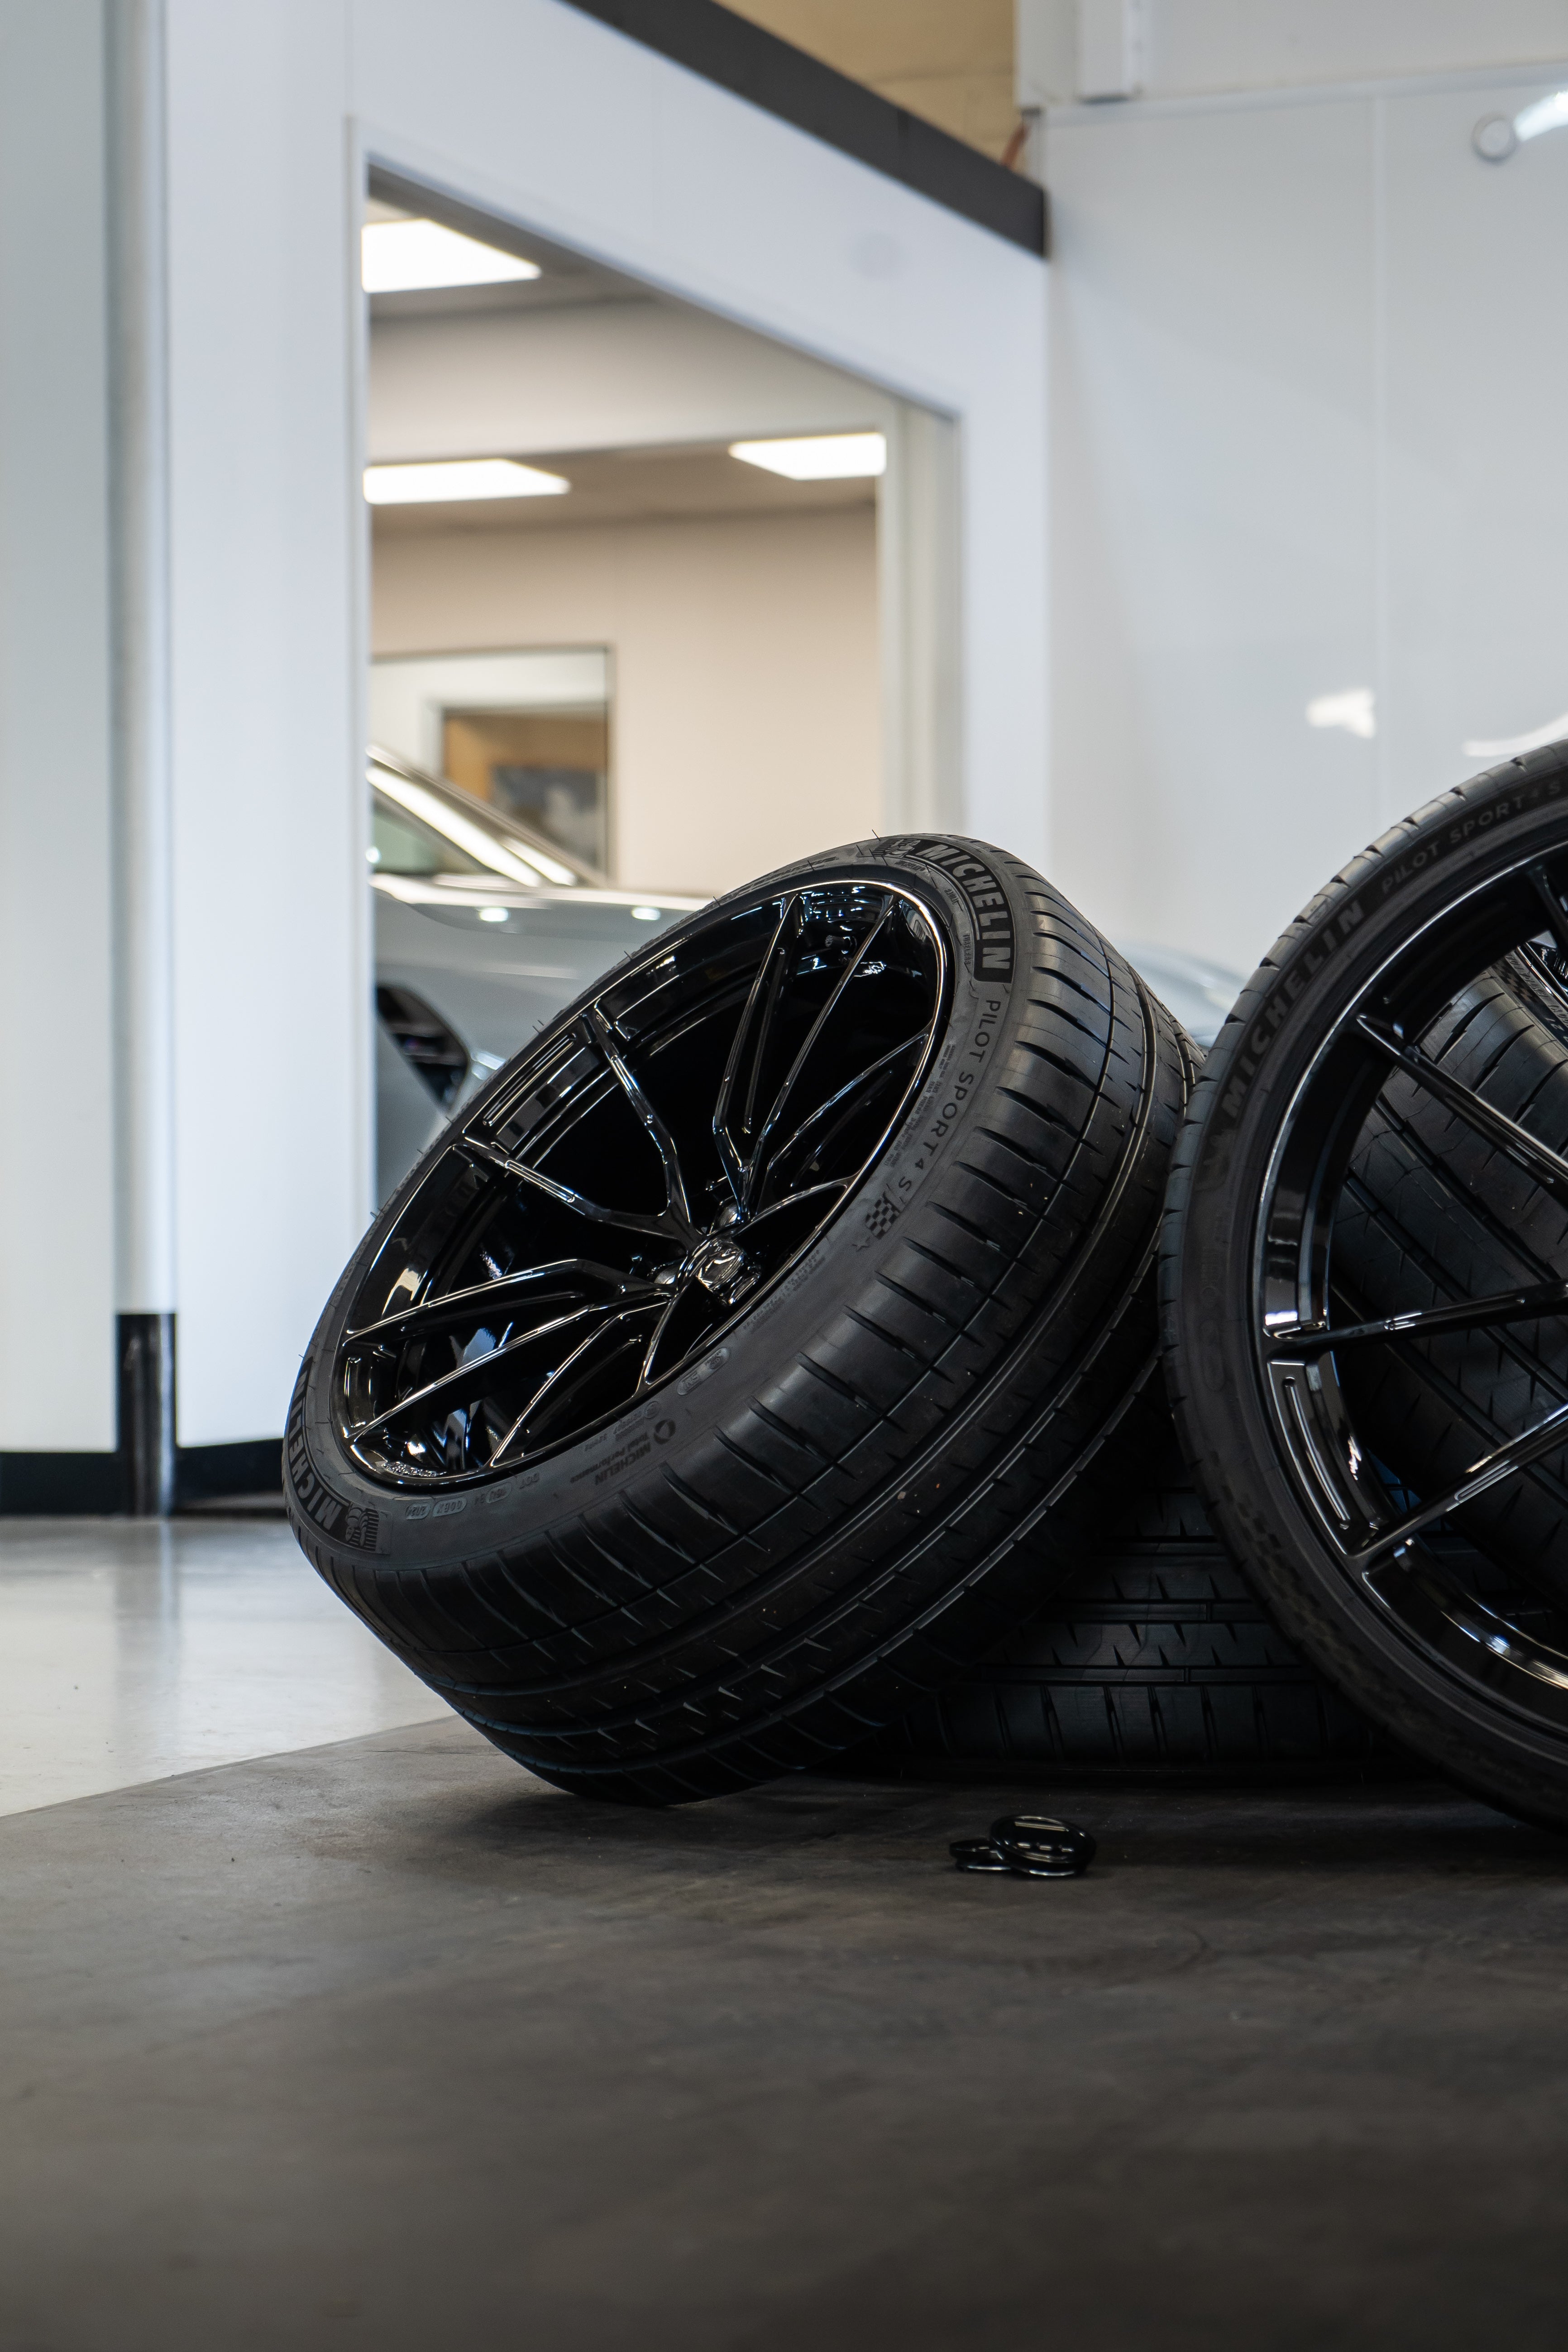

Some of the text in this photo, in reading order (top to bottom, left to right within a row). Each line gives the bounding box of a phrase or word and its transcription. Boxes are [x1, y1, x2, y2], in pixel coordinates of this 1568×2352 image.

[1382, 841, 1440, 894] PILOT
[1450, 795, 1525, 844] SPORT
[1548, 782, 1561, 795] S
[916, 844, 1011, 969] MICHELIN
[969, 999, 1001, 1063] PILOT
[1222, 906, 1365, 1119] MICHELIN
[923, 1071, 974, 1156] SPORT
[898, 1177, 912, 1192] S
[914, 1158, 924, 1170] 4
[289, 1370, 343, 1531] MICHELIN
[570, 1448, 625, 1484] Performance
[595, 1443, 651, 1486] MICHELIN
